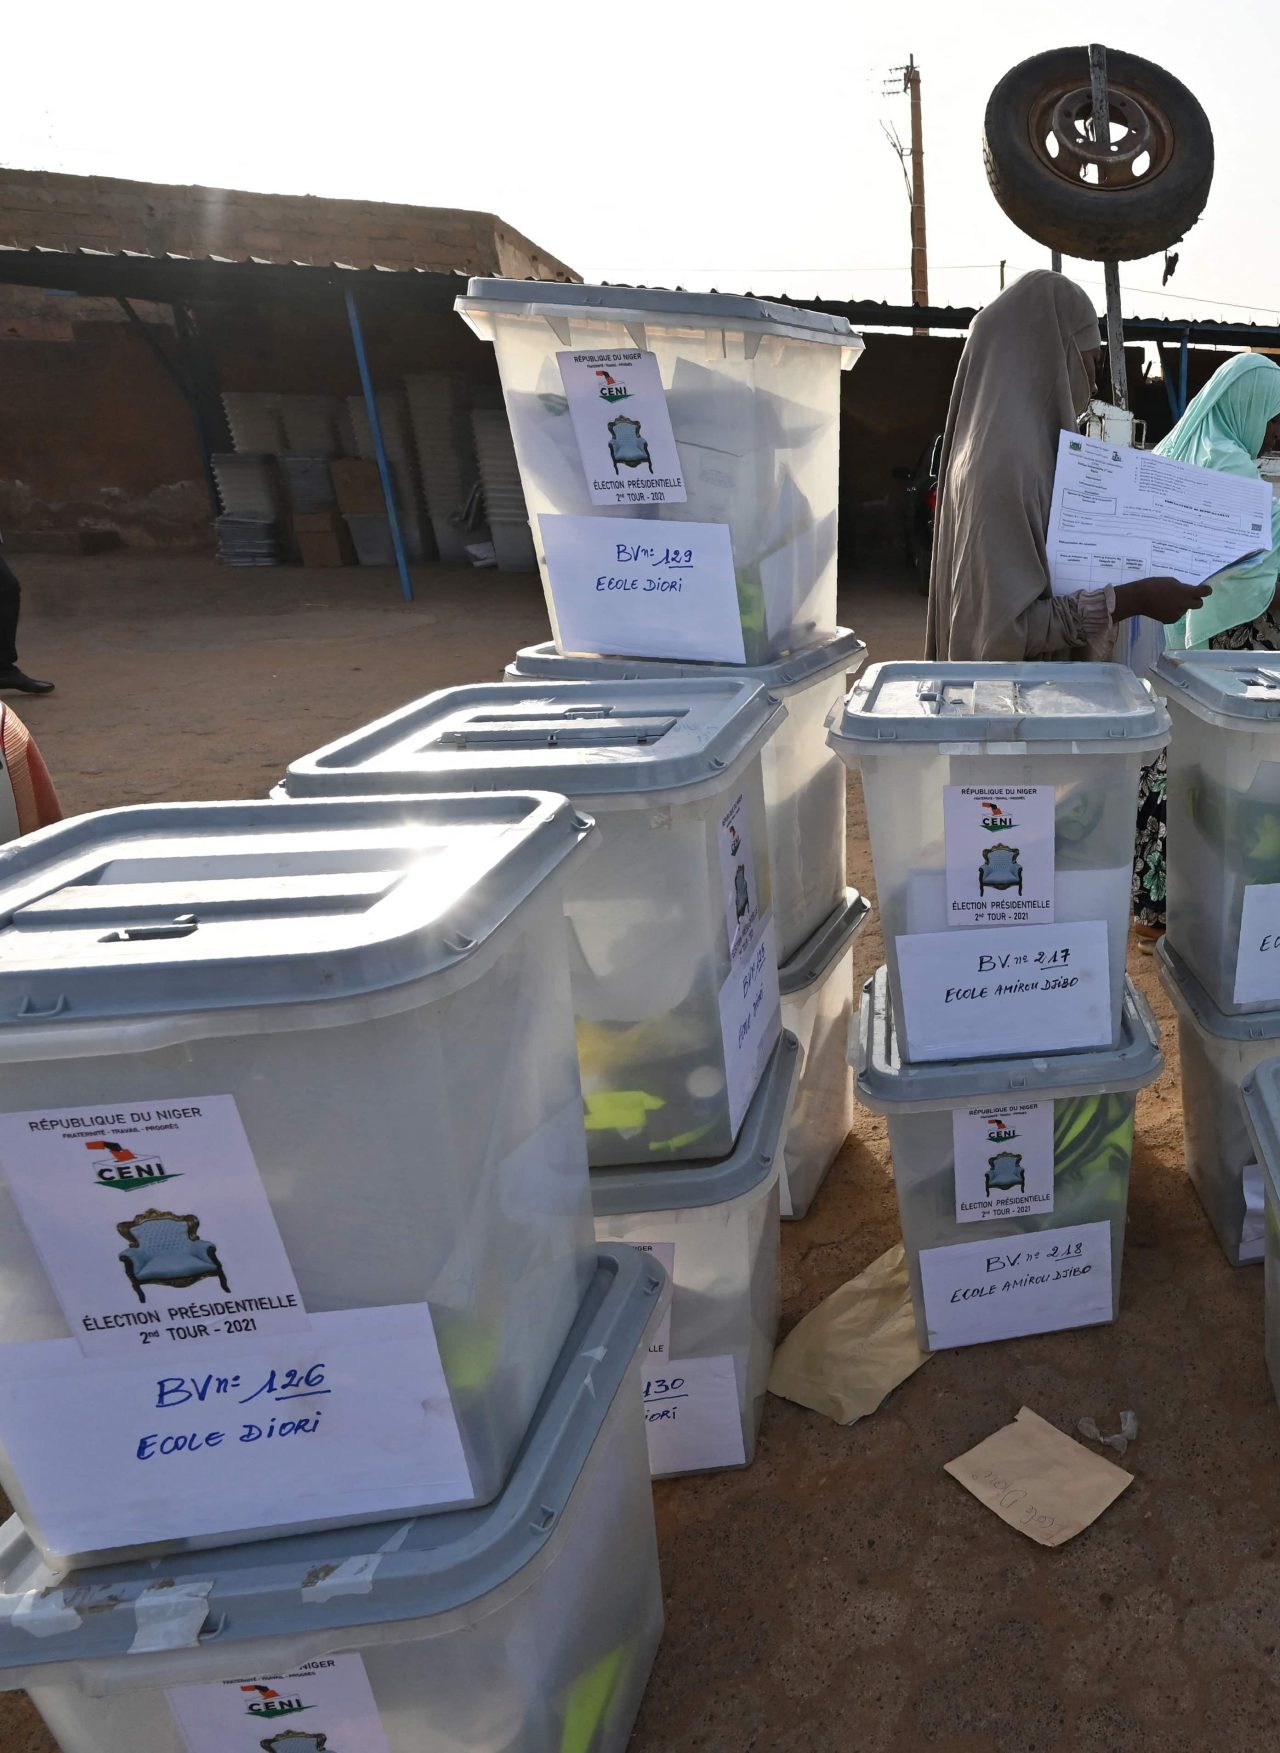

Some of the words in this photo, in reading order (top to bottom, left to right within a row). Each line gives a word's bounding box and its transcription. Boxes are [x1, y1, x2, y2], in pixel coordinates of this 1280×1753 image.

[574, 354, 612, 363] RÉPUBLIQUE
[612, 353, 622, 361] DU
[623, 352, 642, 360] NIGER
[600, 387, 627, 396] CENI
[593, 479, 625, 490] ÉLECTION
[628, 477, 682, 489] PRÉSIDENTIELLE
[627, 492, 646, 501] TOUR
[651, 492, 665, 501] 2021
[652, 548, 693, 566] 129
[982, 817, 1012, 826] CENI
[952, 900, 987, 911] ÉLECTION
[991, 899, 1050, 910] PRÉSIDENTIELLE
[987, 912, 1006, 921] TOUR
[1013, 912, 1029, 920] 2021
[1033, 948, 1070, 965] 217
[944, 988, 988, 1003] ECOLE
[969, 1107, 1008, 1116] RÉPUBLIQUE
[29, 1111, 126, 1132] RÉPUBLIQUE
[131, 1111, 151, 1123] DU
[157, 1107, 202, 1120] NIGER
[988, 1129, 1016, 1138] CENI
[97, 1162, 165, 1181] CENI
[960, 1200, 993, 1211] ÉLECTION
[996, 1193, 1050, 1206] PRÉSIDENTIELLE
[993, 1208, 1011, 1216] TOUR
[1017, 1205, 1031, 1214] 2021
[1046, 1242, 1083, 1259] 218
[950, 1284, 997, 1304] ECOLE
[82, 1310, 161, 1332] ÉLECTION
[168, 1294, 298, 1322] PRÉSIDENTIELLE
[166, 1325, 210, 1341] TOUR
[224, 1319, 257, 1334] 2021
[239, 1363, 326, 1404] 126
[137, 1431, 225, 1460] ECOLE
[248, 1698, 302, 1712] CENI
